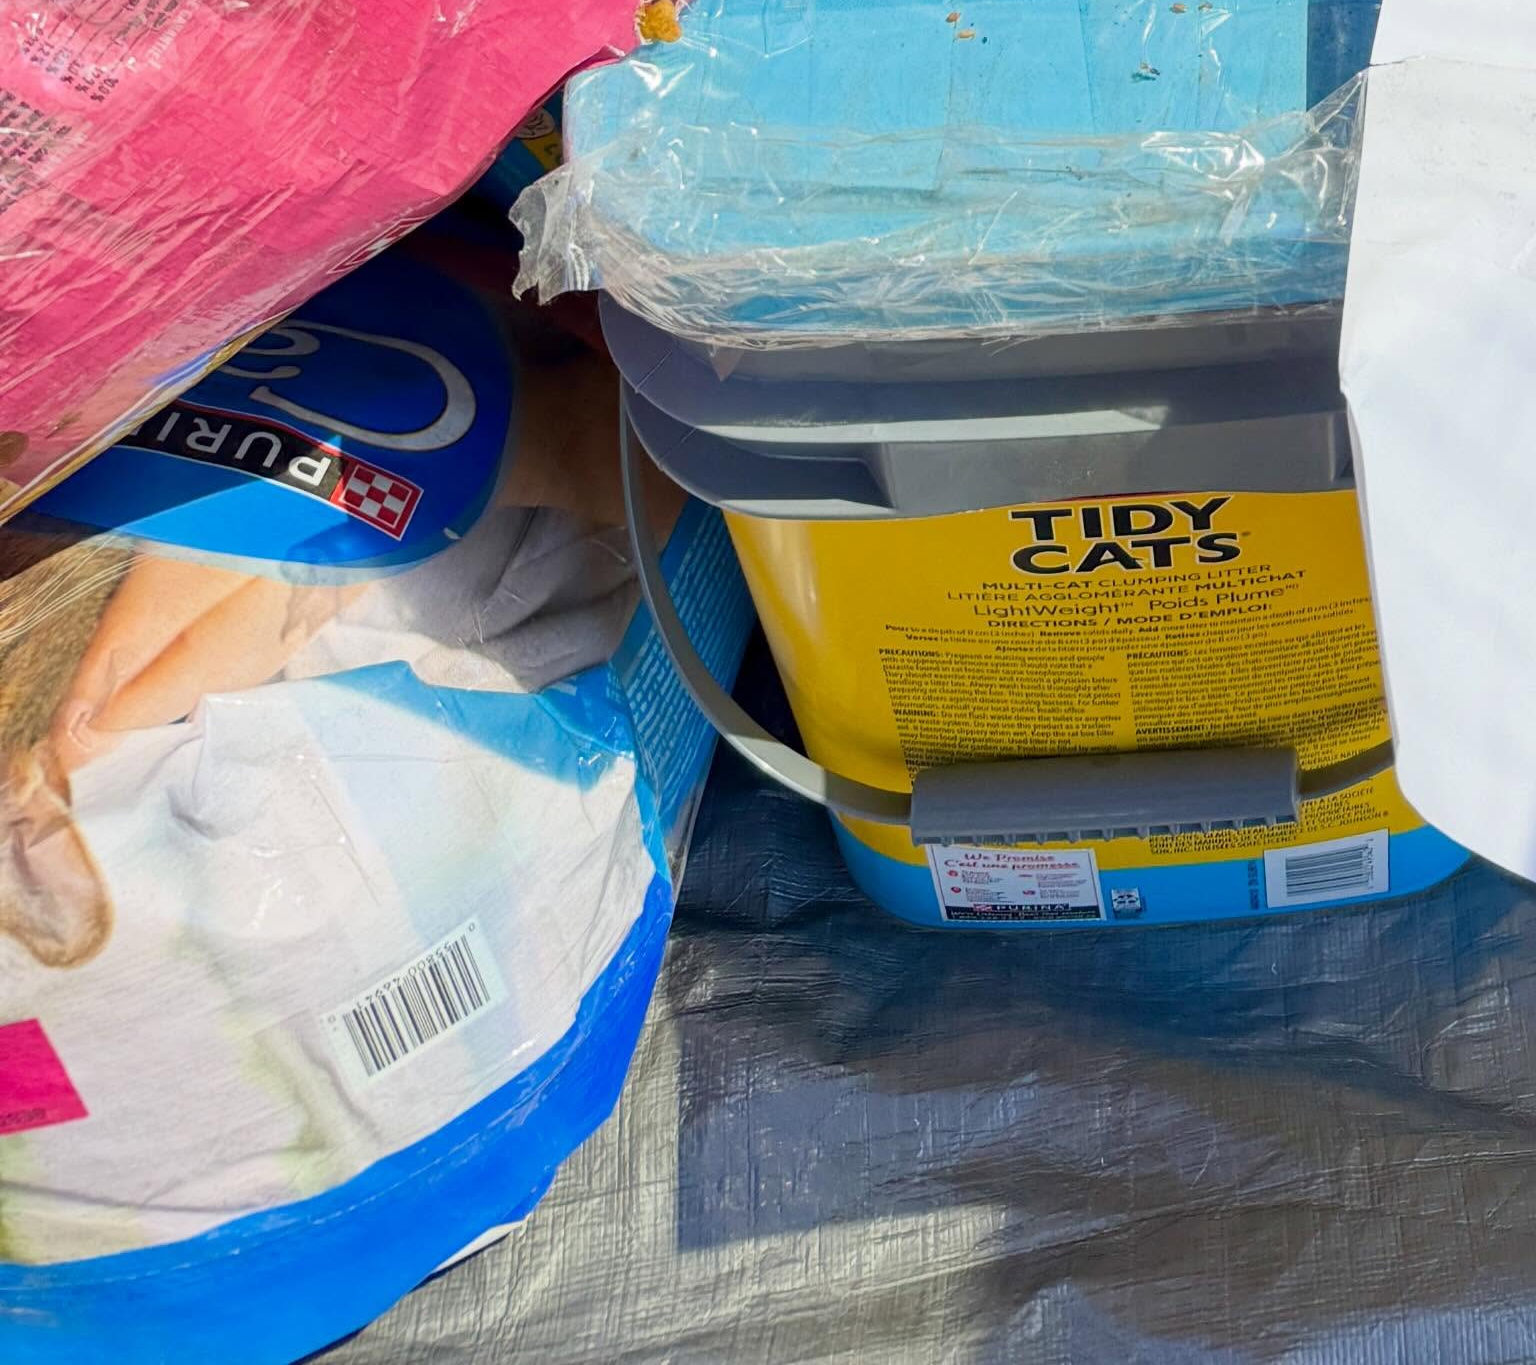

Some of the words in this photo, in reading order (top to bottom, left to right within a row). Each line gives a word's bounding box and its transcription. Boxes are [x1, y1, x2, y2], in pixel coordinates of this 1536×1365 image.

[150, 412, 332, 487] PURI
[1009, 495, 1235, 542] TIDY
[1011, 533, 1243, 574] CATS
[947, 588, 1020, 602] LITIÈRE
[1025, 583, 1190, 603] AGGLOMÉRANTE
[1194, 569, 1306, 592] MULTICHAT
[983, 577, 1093, 591] MULTI-CAT
[1098, 572, 1200, 589] CLUMPING
[1207, 564, 1272, 580] LITTER
[987, 617, 1098, 630] DIRECTIONS
[1116, 613, 1170, 626] MODE
[1175, 602, 1273, 622] D'EMPLOI:
[1149, 593, 1208, 612] Poids
[994, 851, 1055, 865] Promise
